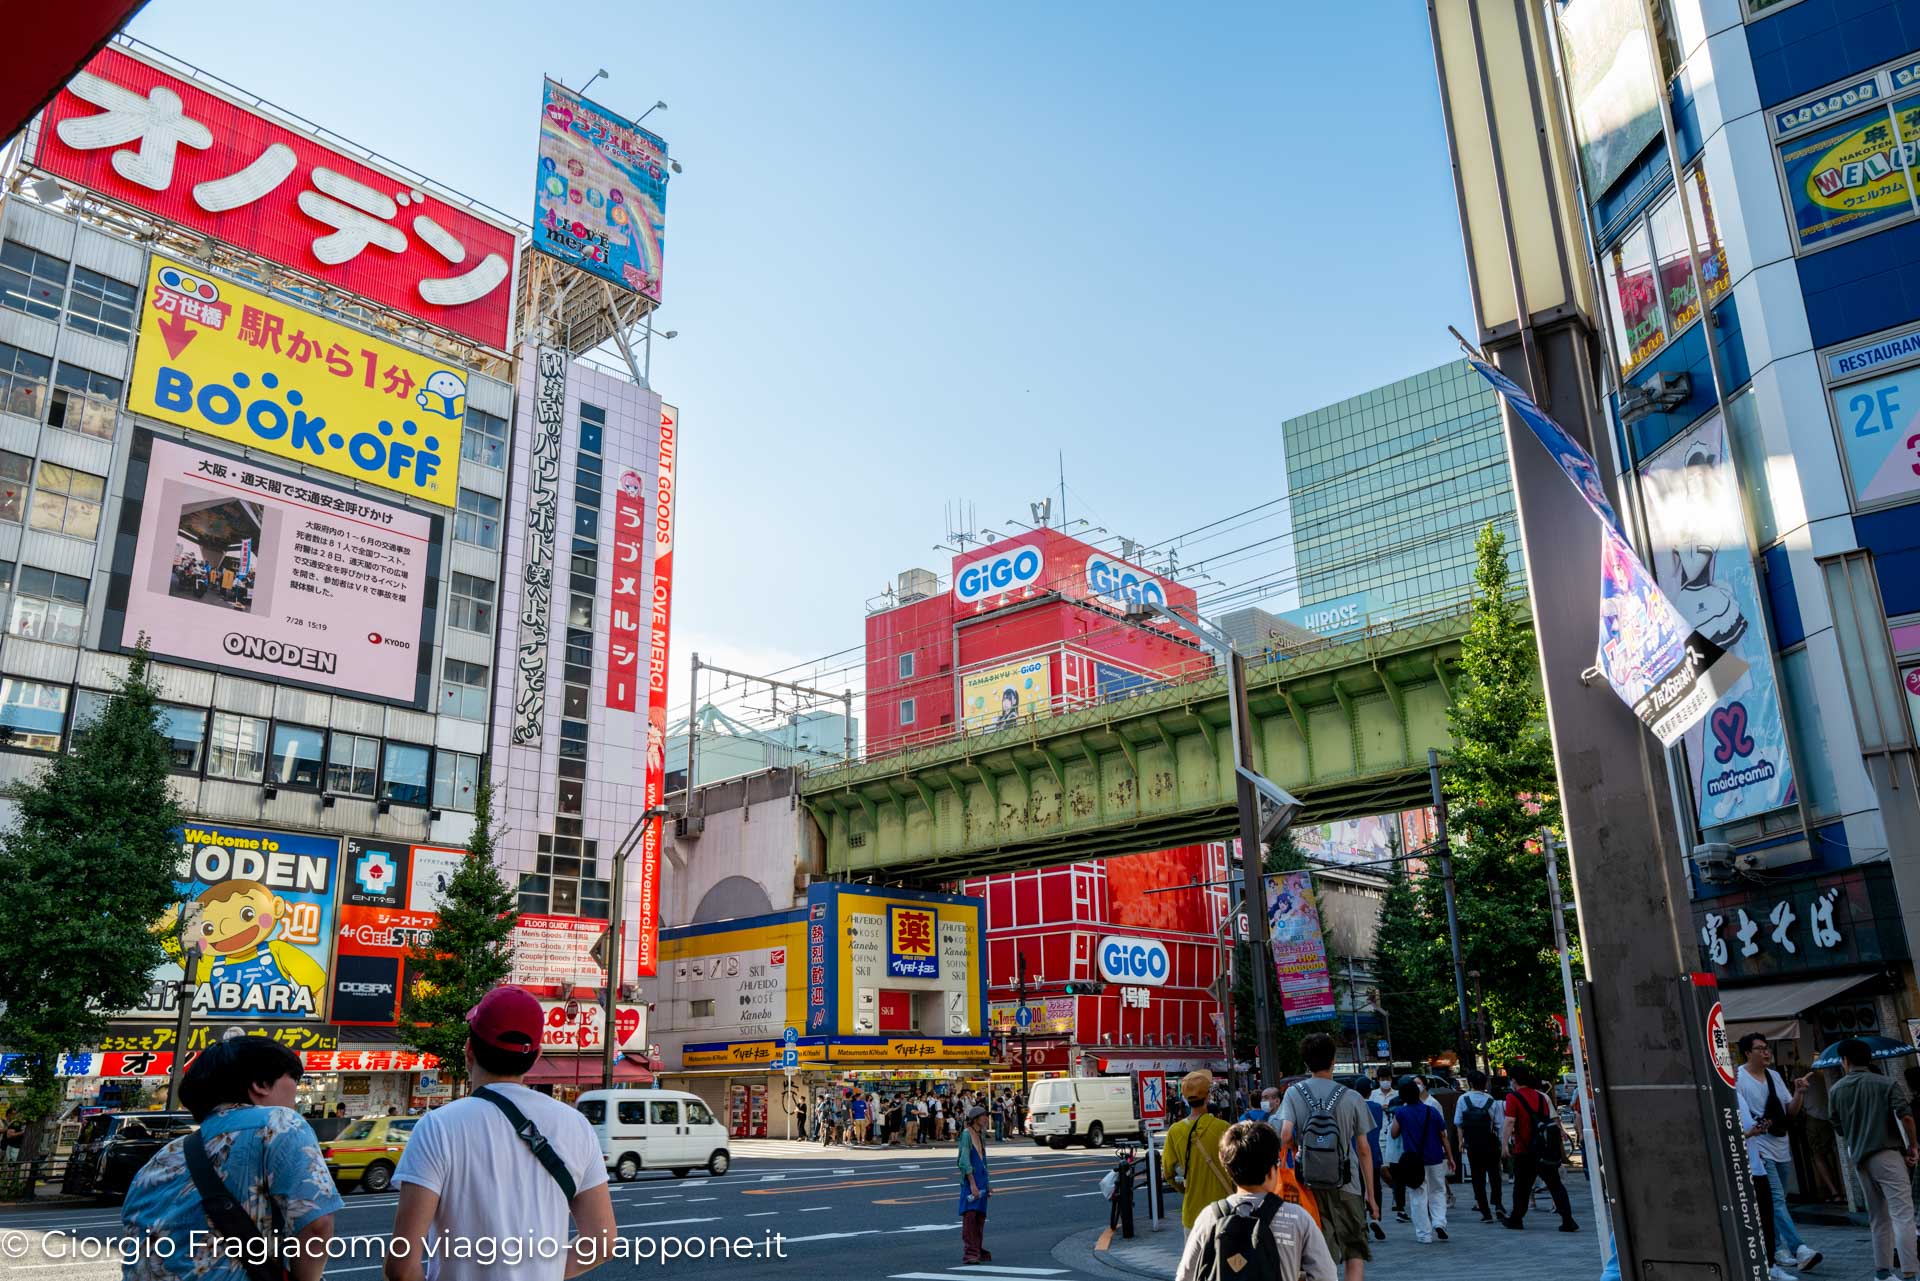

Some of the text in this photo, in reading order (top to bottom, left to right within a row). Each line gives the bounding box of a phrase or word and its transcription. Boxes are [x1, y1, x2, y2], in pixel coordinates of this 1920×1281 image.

[1816, 137, 1920, 192] WELC
[1839, 140, 1893, 162] HAKOTEN
[57, 70, 509, 306] オノデン
[1843, 182, 1905, 208] ウェルカム
[560, 216, 609, 248] LOVE
[153, 288, 225, 330] 万世橋
[238, 305, 418, 400] 駅から1分
[1849, 385, 1900, 438] 2F
[198, 460, 394, 525] 大阪・通天閣で交通安全呼びかけ
[656, 413, 674, 545] ADULT GOODS
[959, 550, 1039, 598] GiGO
[612, 506, 640, 701] ラブメルシー
[1304, 603, 1359, 633] HIROSE
[286, 615, 328, 631] 7/28 15:19
[650, 575, 668, 693] LOVE MERCI
[223, 632, 336, 674] ONODEN
[384, 637, 410, 649] KYODO
[1708, 759, 1774, 796] maidreamin
[184, 829, 279, 852] Welcome to
[348, 842, 361, 854] 5F
[640, 783, 656, 966] wwakibalovemerci.com
[339, 924, 356, 938] 4F
[377, 914, 433, 926] ジーストア
[521, 930, 540, 938] Men's
[524, 920, 548, 928] FLOOR
[549, 921, 569, 929] GUIDE
[898, 911, 931, 953] 薬
[519, 952, 547, 961] Couple's
[549, 953, 571, 961] Goods
[848, 940, 878, 951] Kanebo
[519, 963, 549, 971] Costume
[550, 964, 577, 973] Lingerie
[1104, 943, 1166, 979] GiGO
[338, 981, 393, 994] COSPA
[518, 975, 539, 983] Fetish
[740, 1008, 772, 1021] Kanebo
[786, 1053, 796, 1065] P
[1723, 1107, 1733, 1130] No
[1728, 1133, 1752, 1231] solicitation/
[1747, 1236, 1757, 1259] No
